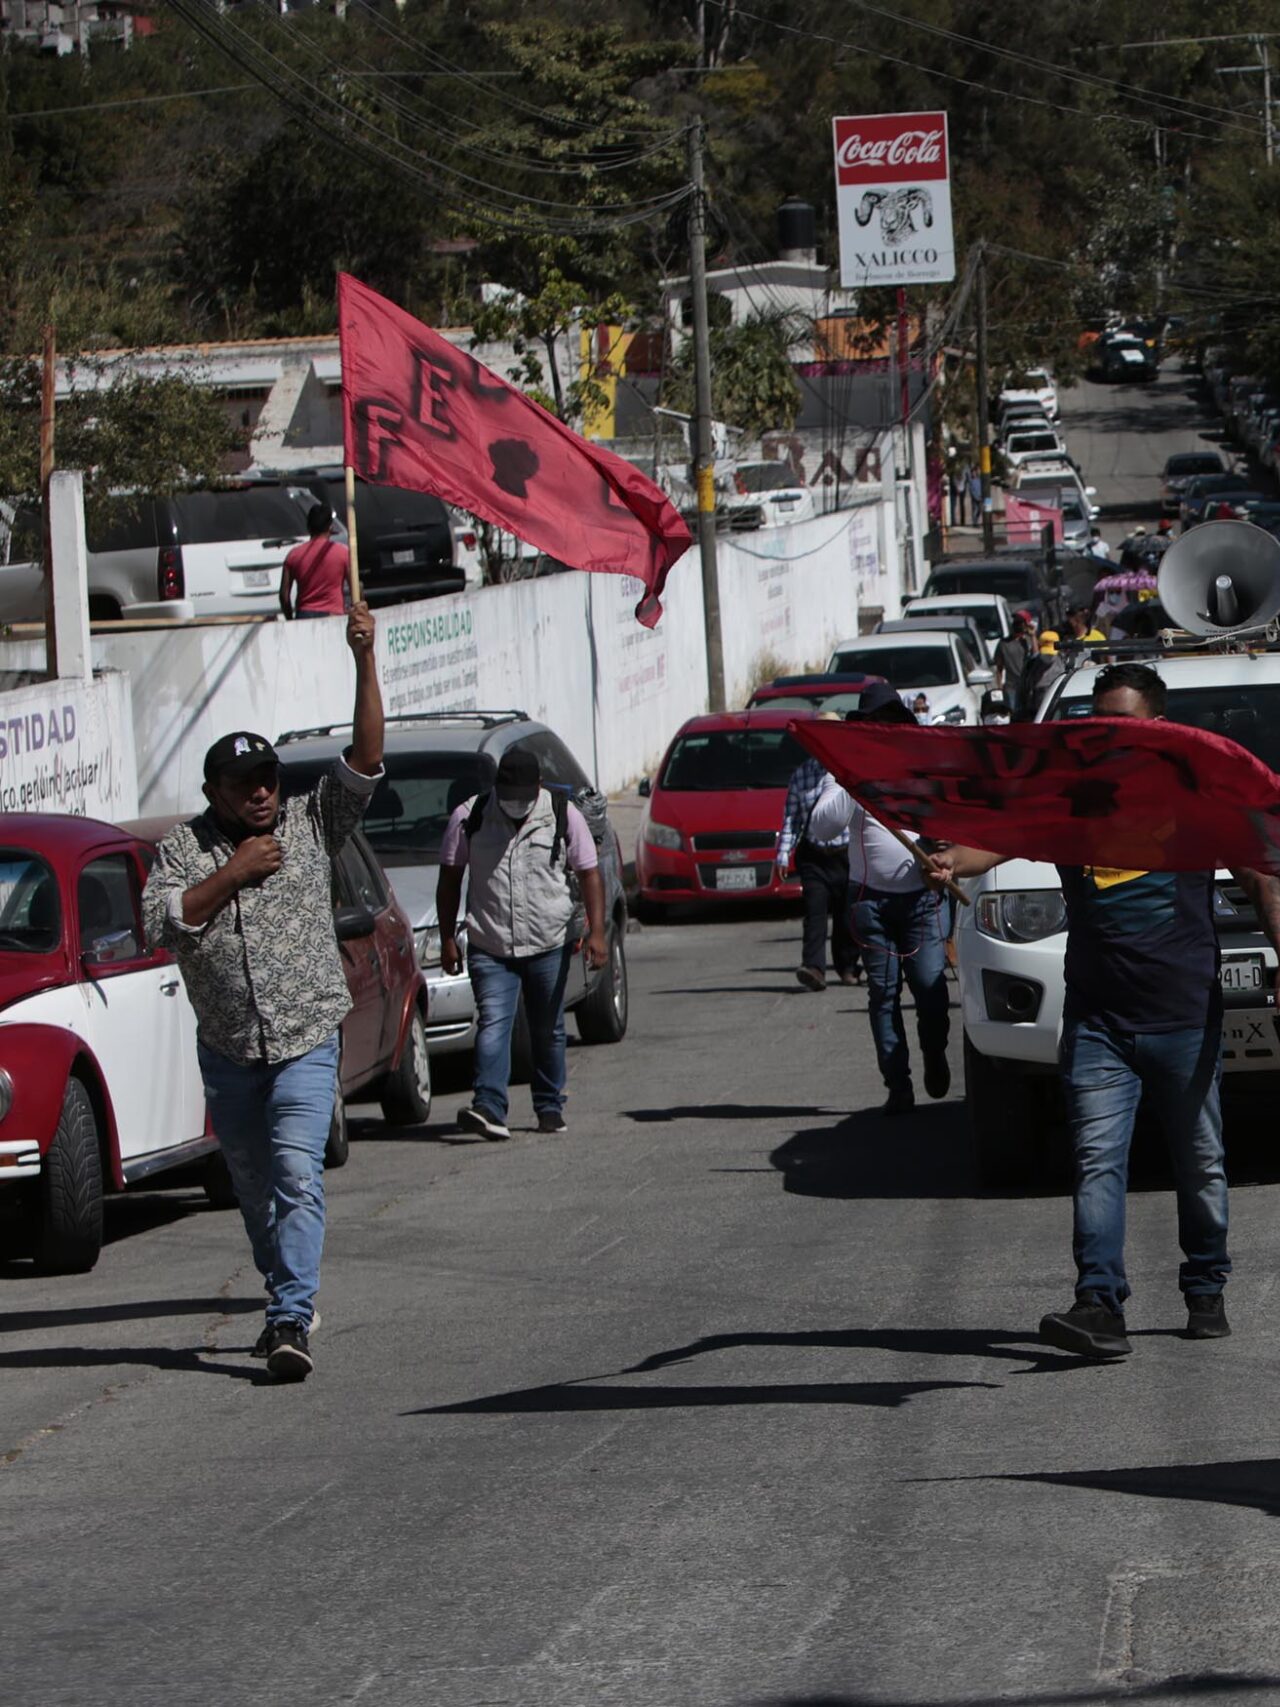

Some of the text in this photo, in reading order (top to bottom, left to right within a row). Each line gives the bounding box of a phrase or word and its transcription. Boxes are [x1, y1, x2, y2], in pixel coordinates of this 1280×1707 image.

[837, 129, 944, 168] Coca-Cola
[855, 248, 938, 268] XALICCO
[387, 610, 472, 656] RESPONSABILIDAD
